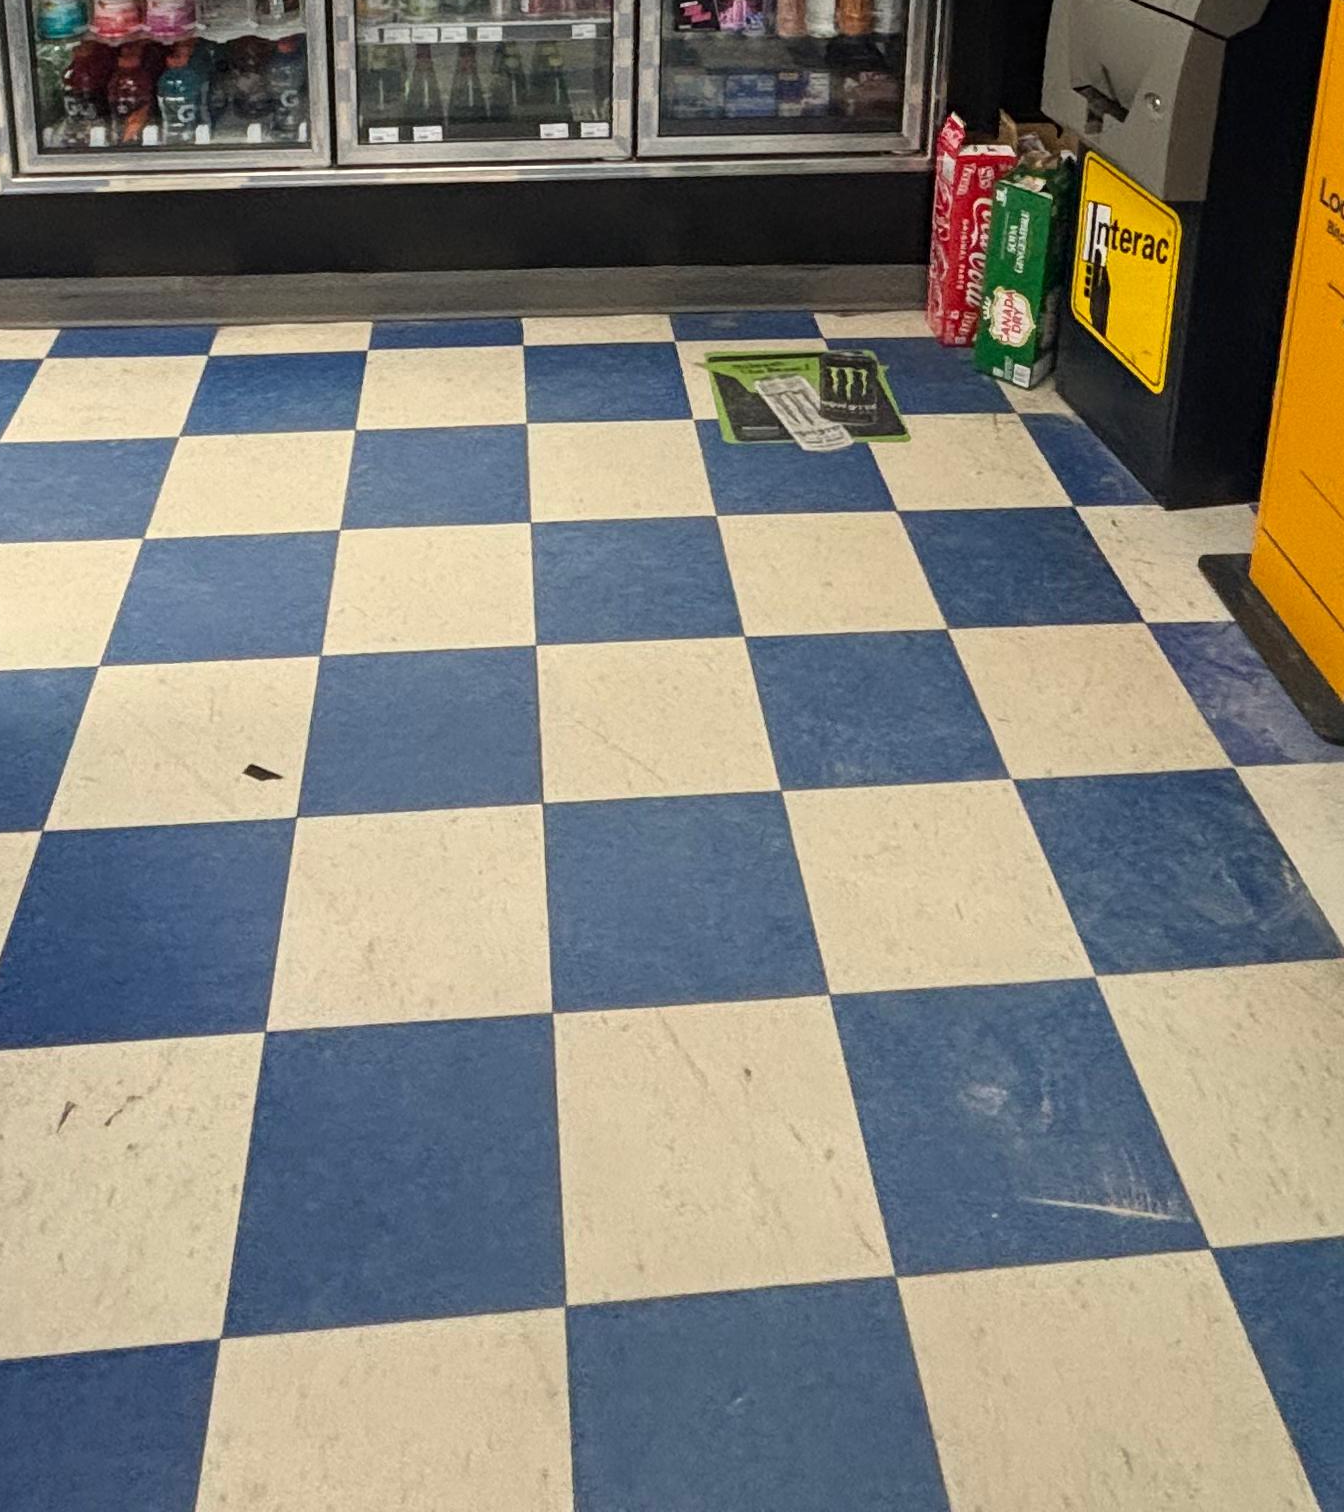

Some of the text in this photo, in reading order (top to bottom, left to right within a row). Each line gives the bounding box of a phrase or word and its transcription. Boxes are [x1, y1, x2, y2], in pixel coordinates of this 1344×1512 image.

[1092, 201, 1170, 265] Interac
[1000, 289, 1017, 344] CANADA
[1011, 307, 1025, 335] DRY
